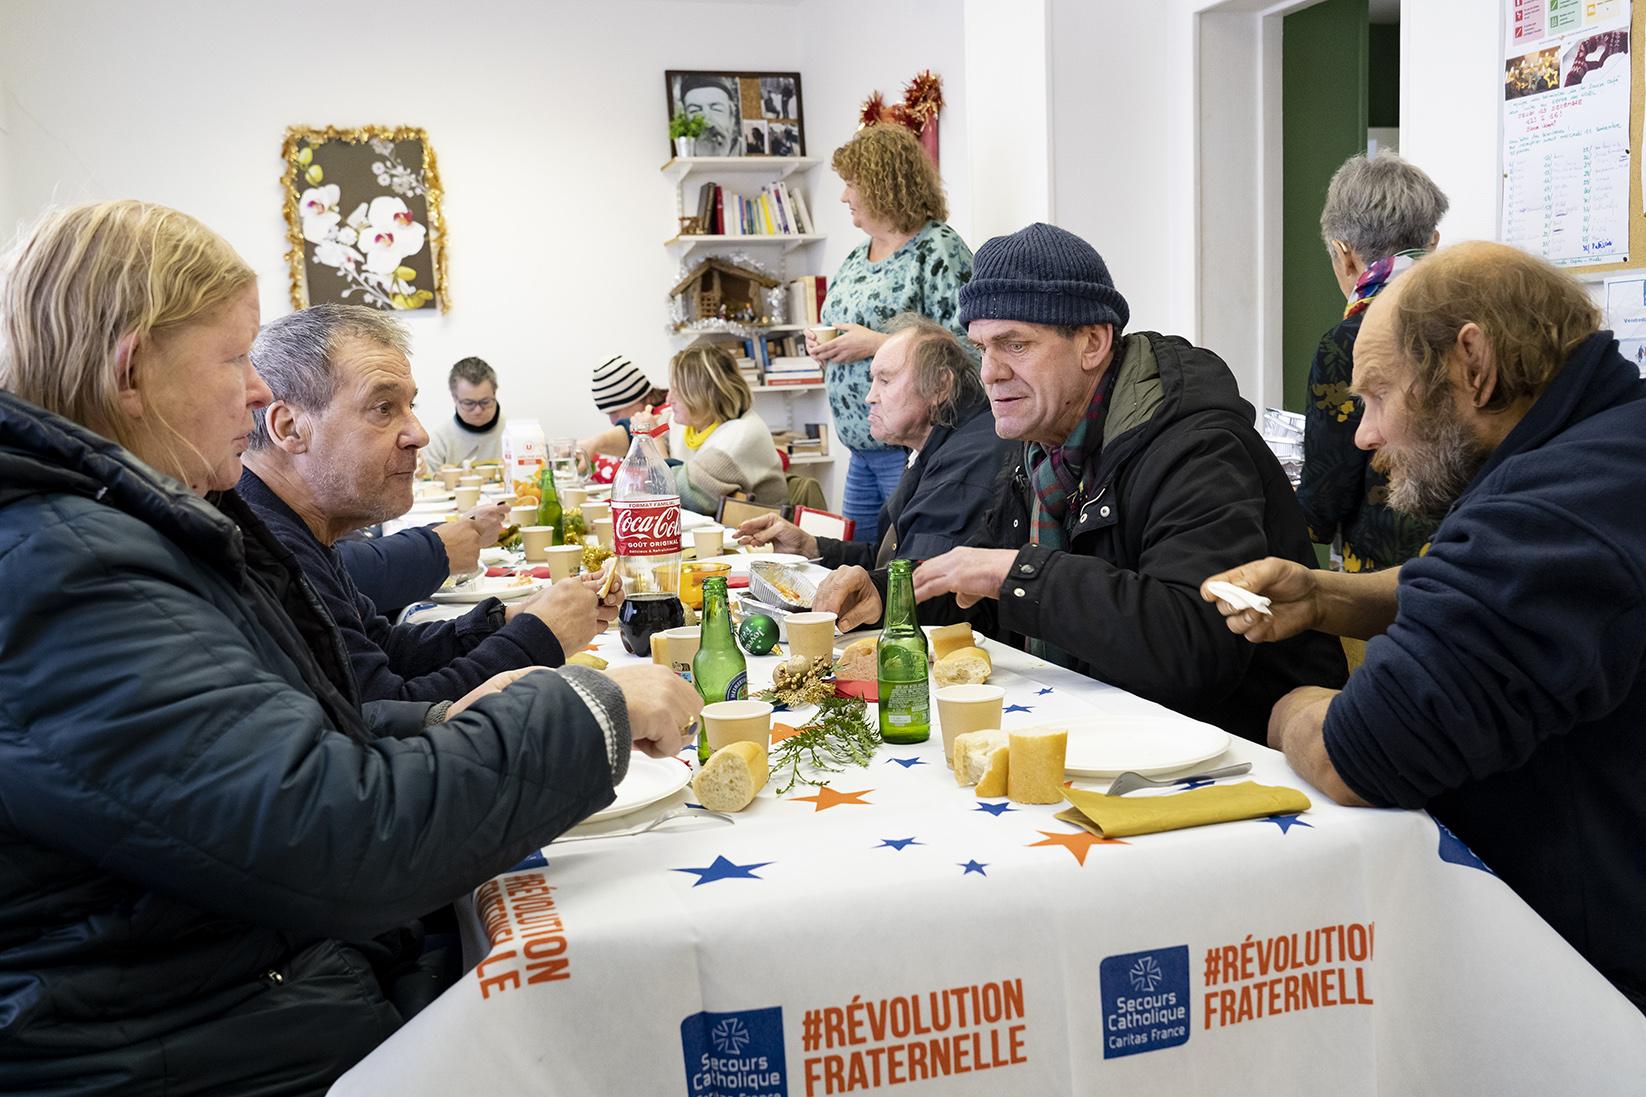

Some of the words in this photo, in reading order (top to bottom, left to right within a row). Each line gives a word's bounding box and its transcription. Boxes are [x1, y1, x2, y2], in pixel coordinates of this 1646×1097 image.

[650, 538, 678, 547] ORIGINAL
[504, 873, 571, 985] #RÉVOLUTION
[1116, 991, 1177, 1014] Secours
[1204, 967, 1374, 1030] FRATERNELL
[802, 978, 1025, 1052] #RÉVOLUTION
[1107, 1006, 1186, 1033] Catholique
[1108, 1032, 1149, 1050] Caritas
[1151, 1025, 1186, 1042] France
[701, 1052, 768, 1072] Secours
[804, 1024, 1028, 1097] FRATERNELLE
[693, 1069, 780, 1091] Catholique
